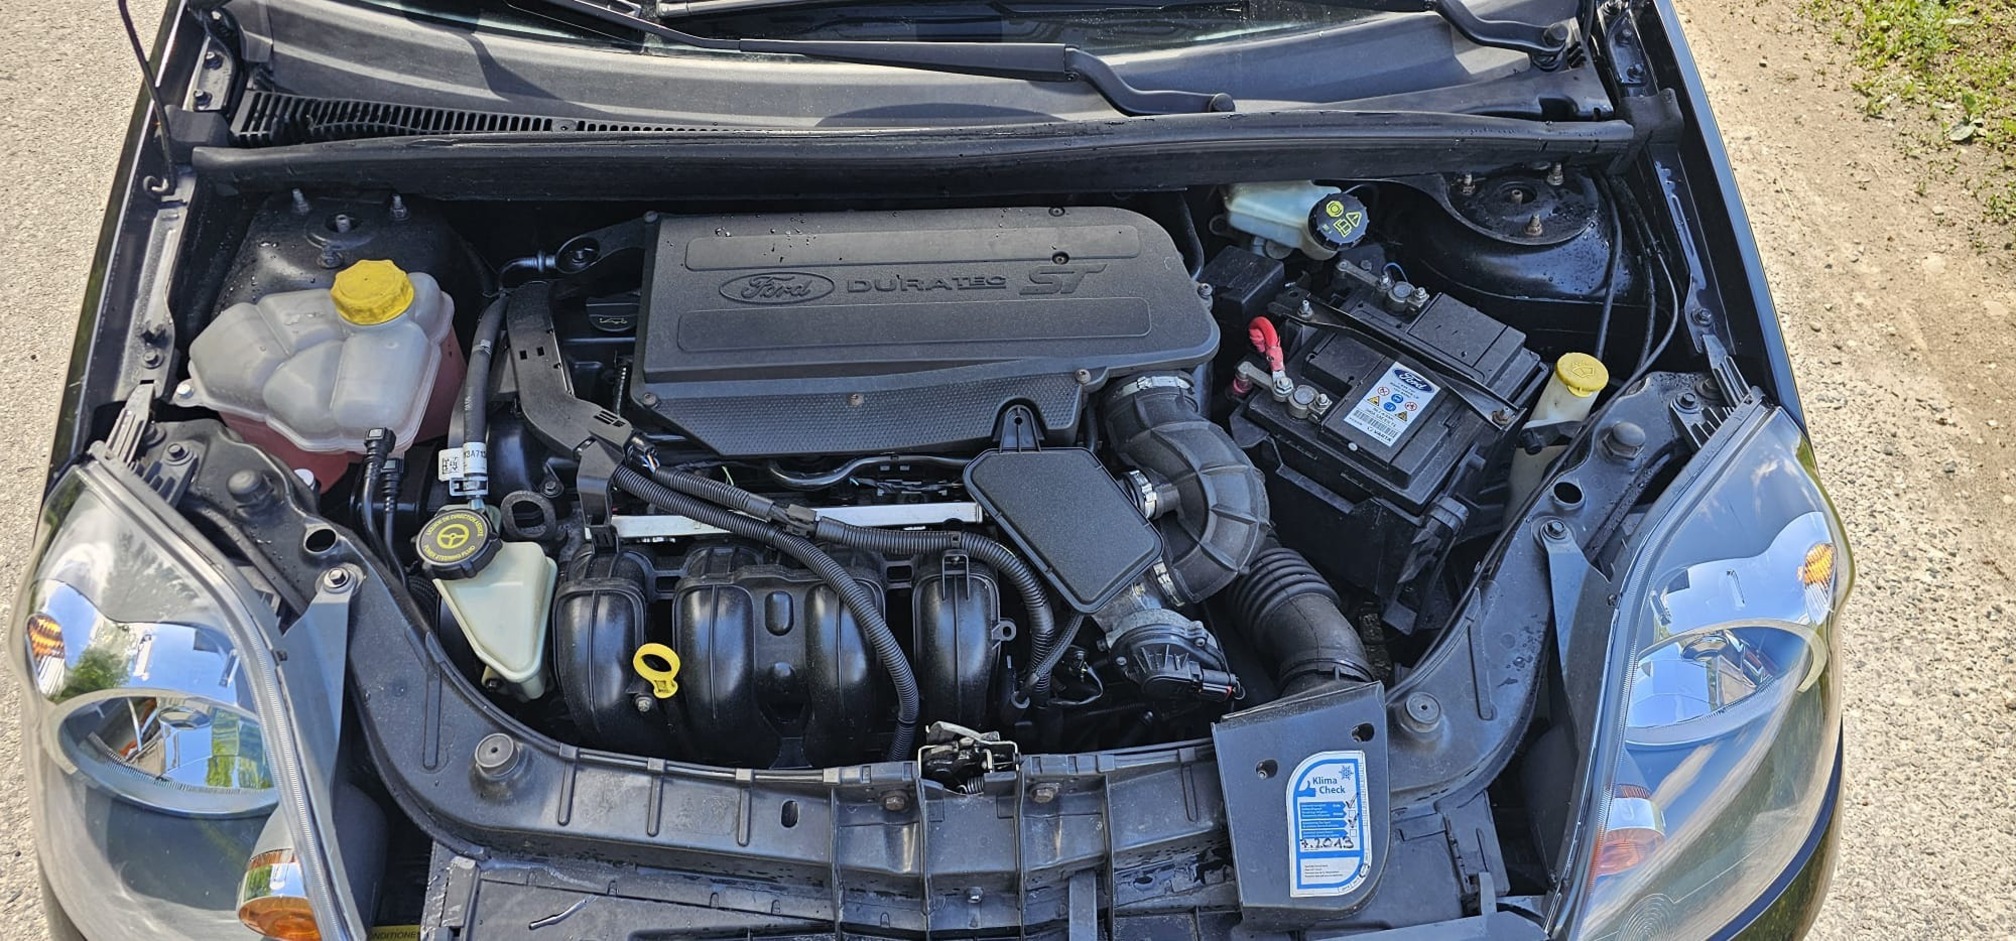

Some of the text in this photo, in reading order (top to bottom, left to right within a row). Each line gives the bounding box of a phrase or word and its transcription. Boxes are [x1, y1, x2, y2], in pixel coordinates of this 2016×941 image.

[847, 273, 1007, 294] DURATEC
[1020, 264, 1109, 296] ST
[1312, 776, 1338, 785] Klima
[1319, 785, 1346, 794] Check
